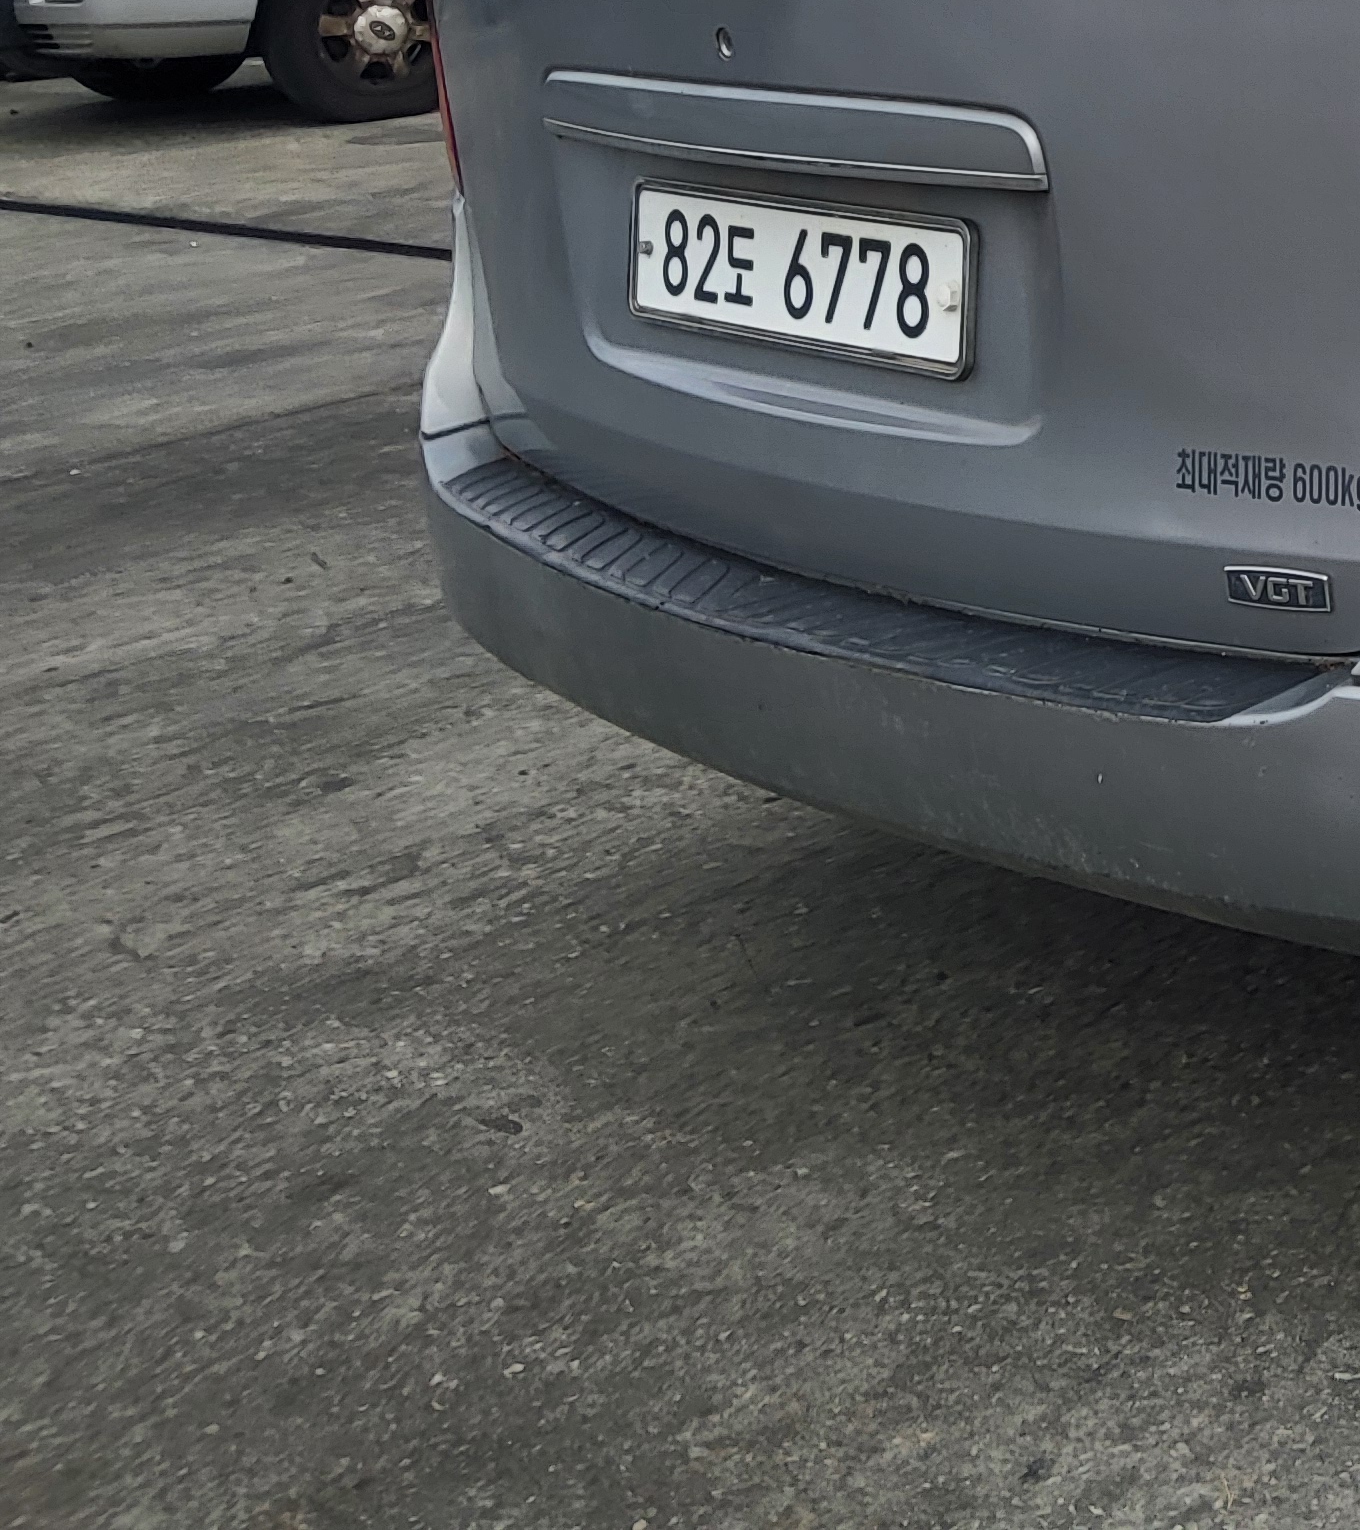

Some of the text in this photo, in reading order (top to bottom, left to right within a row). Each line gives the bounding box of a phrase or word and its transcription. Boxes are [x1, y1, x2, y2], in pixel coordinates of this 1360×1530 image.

[662, 209, 930, 339] 82도 6778
[1175, 448, 1287, 503] 최대적재량
[1239, 573, 1314, 606] VGT
